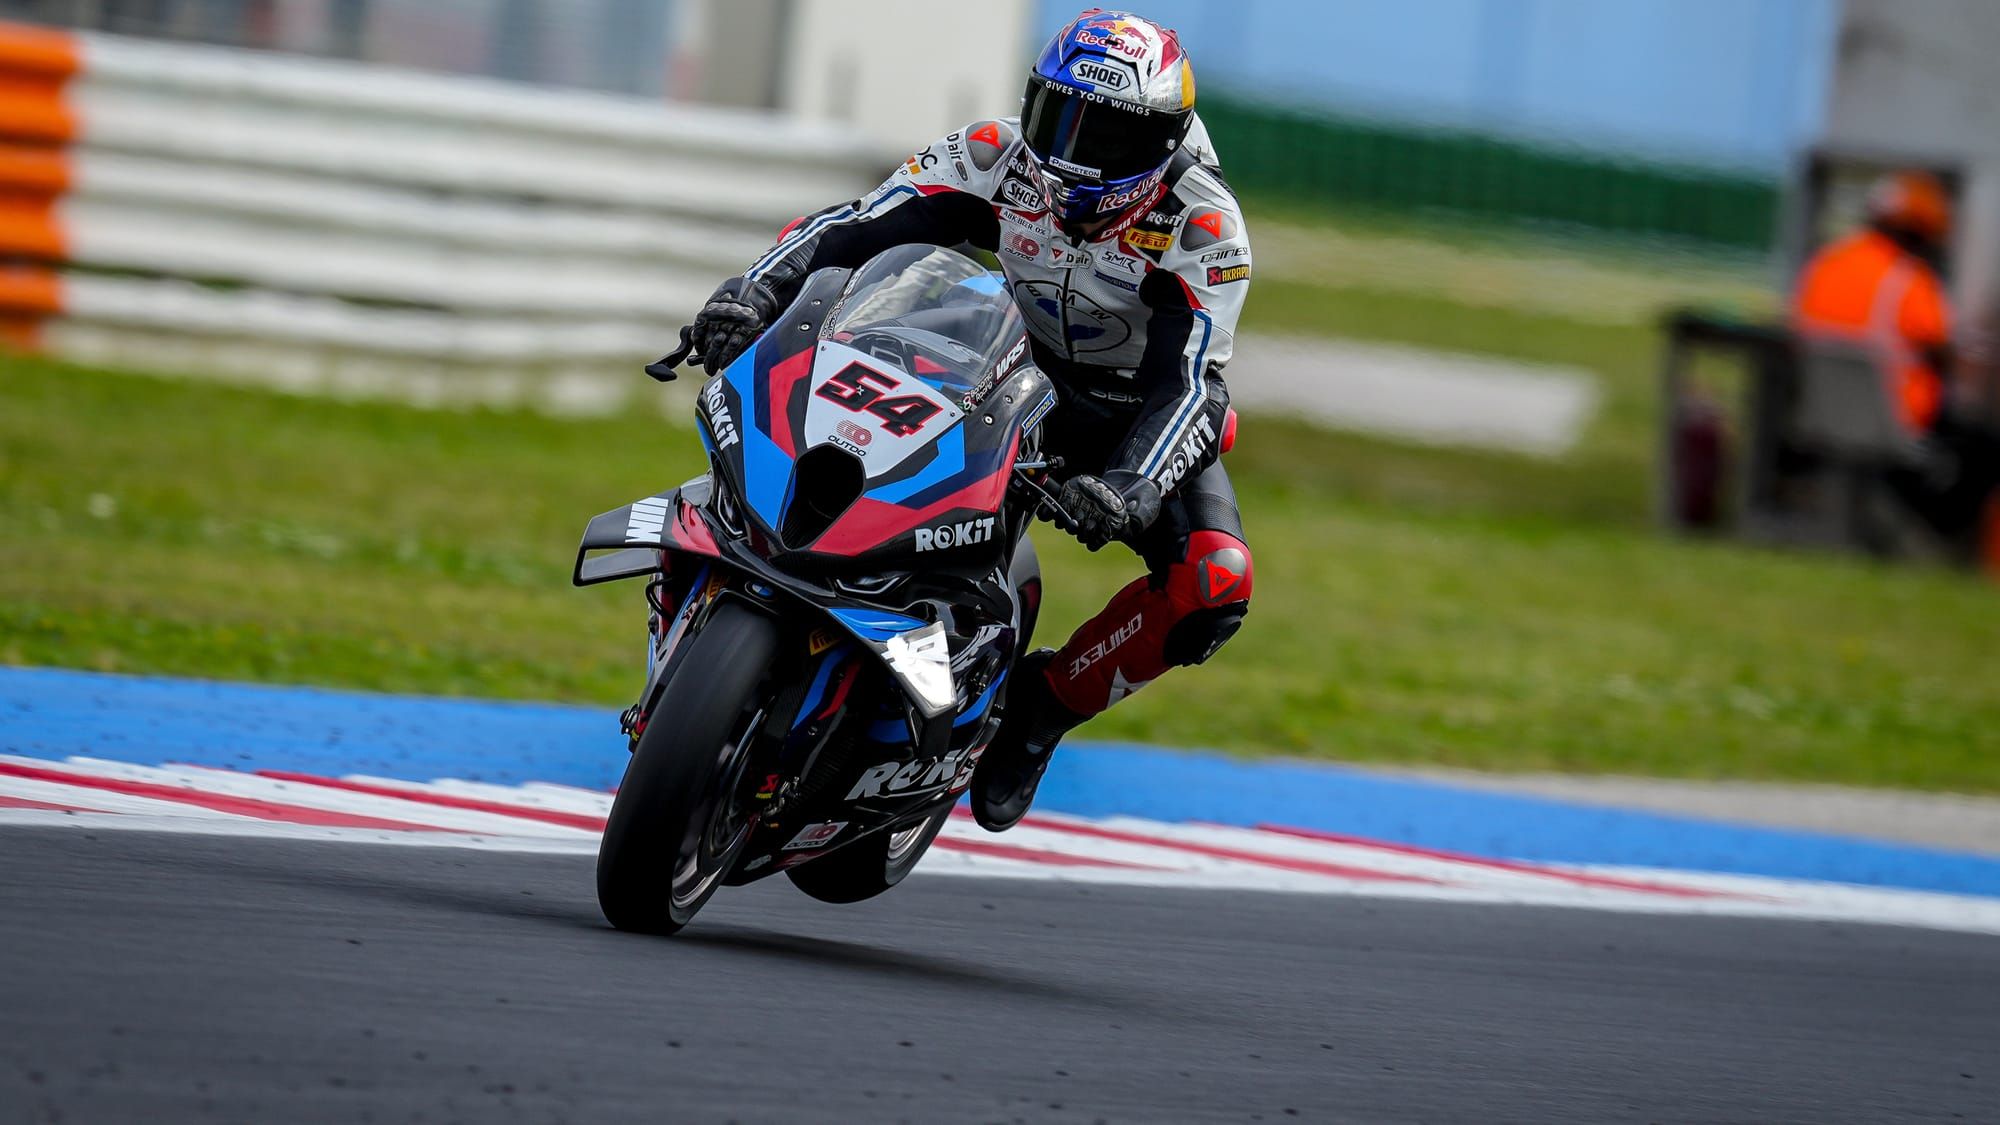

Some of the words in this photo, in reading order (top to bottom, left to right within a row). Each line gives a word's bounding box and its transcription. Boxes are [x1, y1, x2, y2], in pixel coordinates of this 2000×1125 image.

[1075, 30, 1112, 47] Red
[1111, 37, 1147, 60] Bull
[1077, 63, 1123, 88] SHOEI
[1045, 80, 1073, 96] GIVES
[1080, 90, 1104, 104] YOU
[1111, 99, 1150, 116] WINGS
[1051, 158, 1100, 178] PROMETEON
[1007, 182, 1041, 209] SHOEI
[1101, 251, 1137, 274] SMR
[996, 335, 1026, 380] WRS
[815, 360, 944, 438] 54
[828, 434, 867, 457] OUTDO
[1069, 612, 1143, 681] DAINESE
